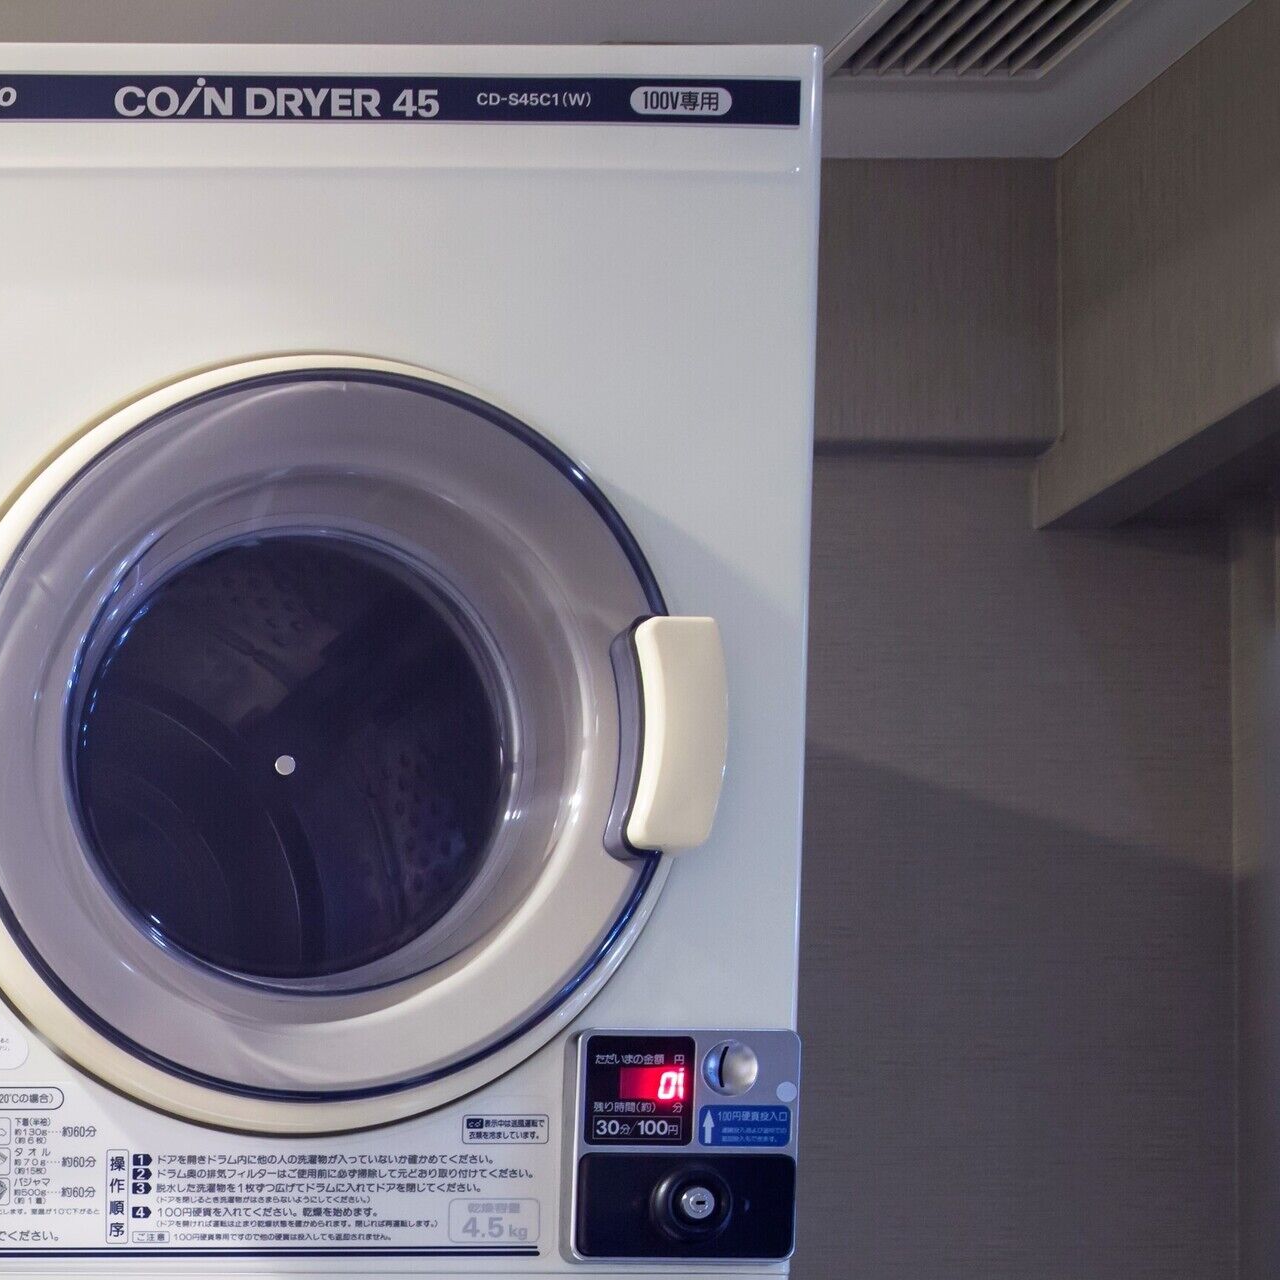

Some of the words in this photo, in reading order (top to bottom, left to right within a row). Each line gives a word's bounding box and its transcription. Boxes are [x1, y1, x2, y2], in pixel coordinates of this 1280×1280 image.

[246, 87, 381, 117] DRYER
[392, 89, 440, 118] 45
[476, 92, 592, 108] CD-S45C1(W)
[643, 90, 719, 111] 100V専用
[595, 1054, 664, 1064] ただいまの金額
[674, 1054, 684, 1064] 円
[594, 1102, 656, 1112] 残り時間(約)
[672, 1103, 683, 1112] 分
[62, 1126, 97, 1138] 約60分
[62, 1156, 96, 1167] 約60分
[61, 1187, 96, 1198] 約60分
[109, 1156, 125, 1237] 操作順序
[462, 1217, 504, 1238] 4.5
[509, 1225, 527, 1240] kg
